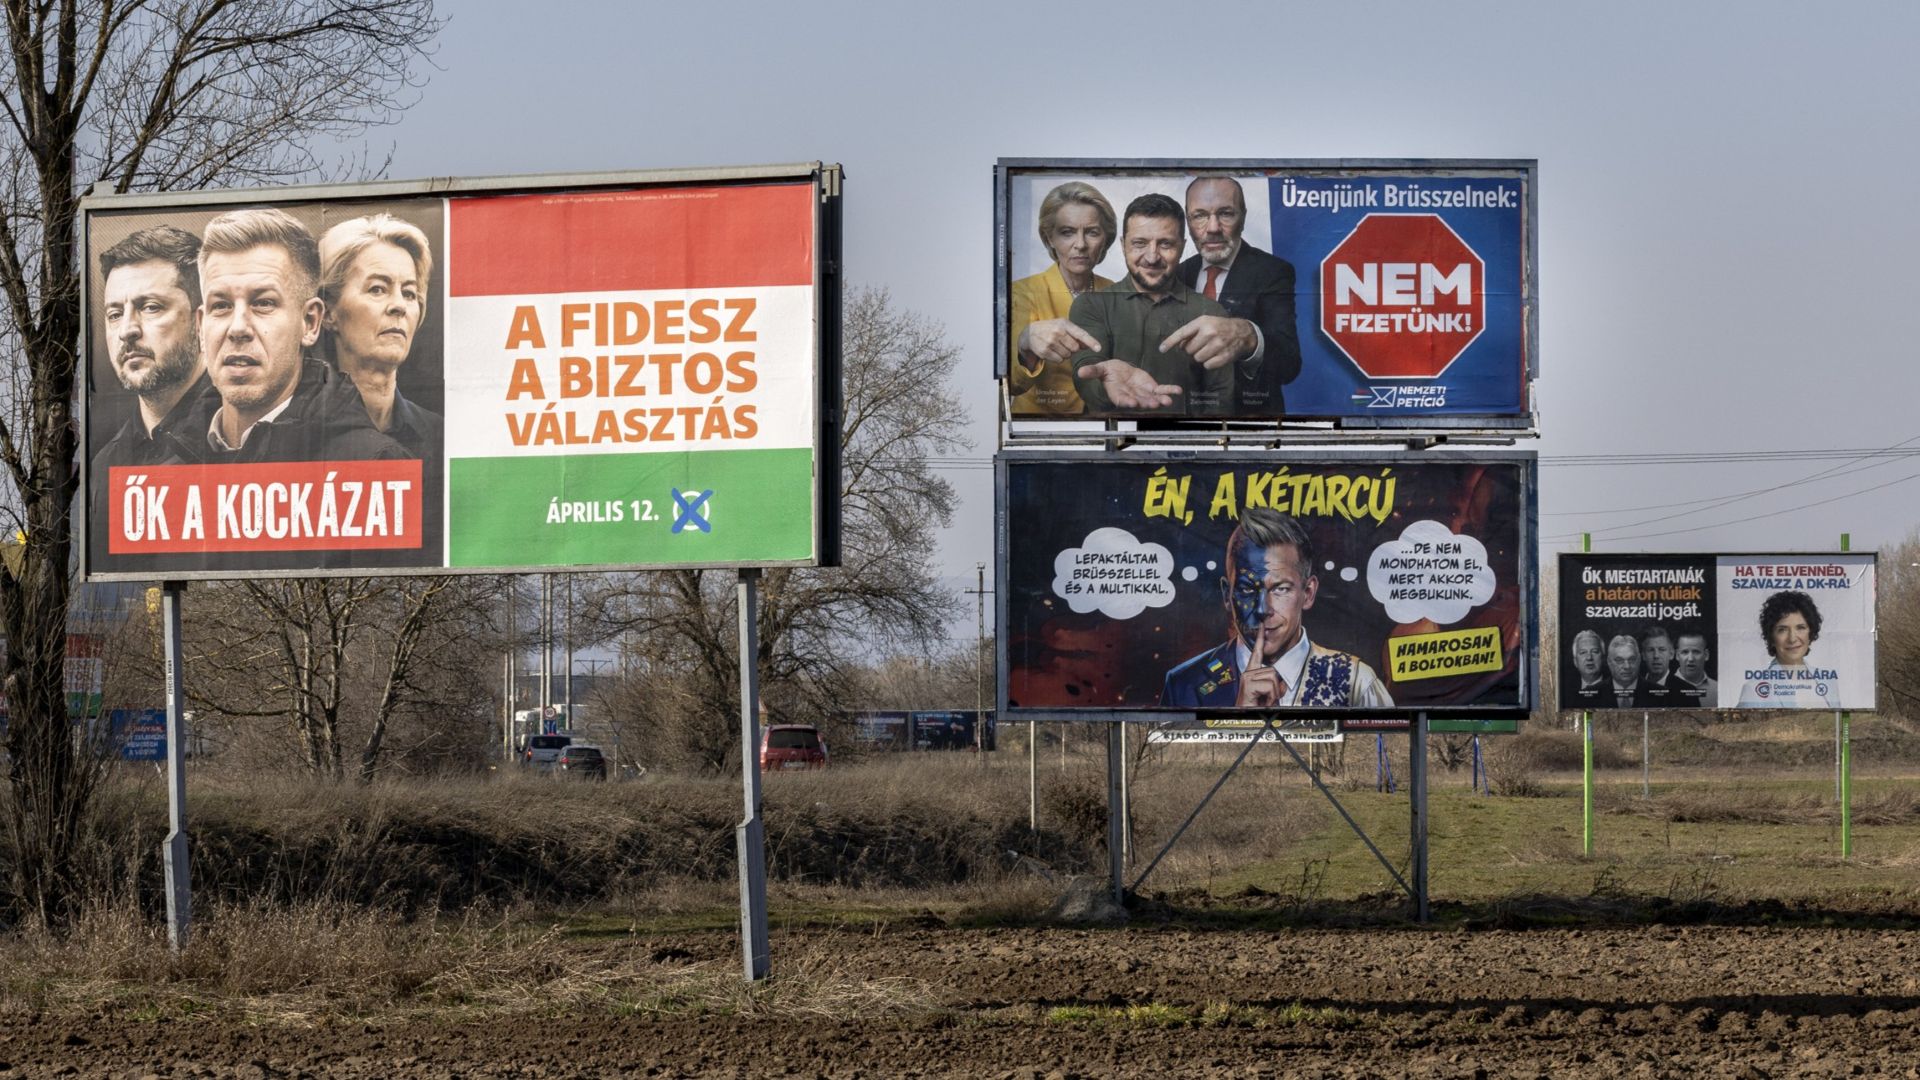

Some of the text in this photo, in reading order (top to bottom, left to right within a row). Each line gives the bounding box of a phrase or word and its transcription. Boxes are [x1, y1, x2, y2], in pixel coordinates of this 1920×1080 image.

[1282, 179, 1517, 213] Üzenjünk Brüsszelnek:
[1335, 263, 1471, 305] NEM
[504, 298, 757, 350] A FIDESZ
[1335, 307, 1472, 333] FIZETÜNK!
[505, 351, 758, 400] A BIZTOS
[1398, 386, 1446, 395] NEMZETI
[1397, 397, 1446, 407] PETÍCIÓ
[505, 396, 758, 446] VÁLASZTÁS
[1143, 465, 1396, 527] ÉN, A KÉTARCÚ
[124, 471, 411, 541] ŐK A KOCKÁZAT
[546, 497, 660, 523] ÁPRILIS 12.
[1401, 543, 1461, 554] ...DE NEM
[1075, 551, 1158, 564] LEPAKTÁLTAM
[1379, 558, 1482, 571] MONDHATOM EL,
[1073, 567, 1160, 579] BRÜSSZELLEL
[1388, 574, 1473, 584] MERT AKKOR
[1582, 566, 1705, 584] ŐK MEGTARTANÁK
[1735, 564, 1846, 578] HA TE ELVENNÉD,
[1065, 581, 1169, 594] ÉS A MULTIKKAL.
[1732, 578, 1850, 589] SZAVAZZ A DK-RA!
[1389, 589, 1473, 600] MEGBUKUNK.
[1585, 585, 1702, 601] a határon túliak
[1585, 602, 1702, 620] szavazati jogát.
[1396, 634, 1494, 658] HAMAROSAN
[1397, 651, 1496, 673] A BOLTOKBAN!
[1745, 668, 1839, 680] DOBREV KLÁRA
